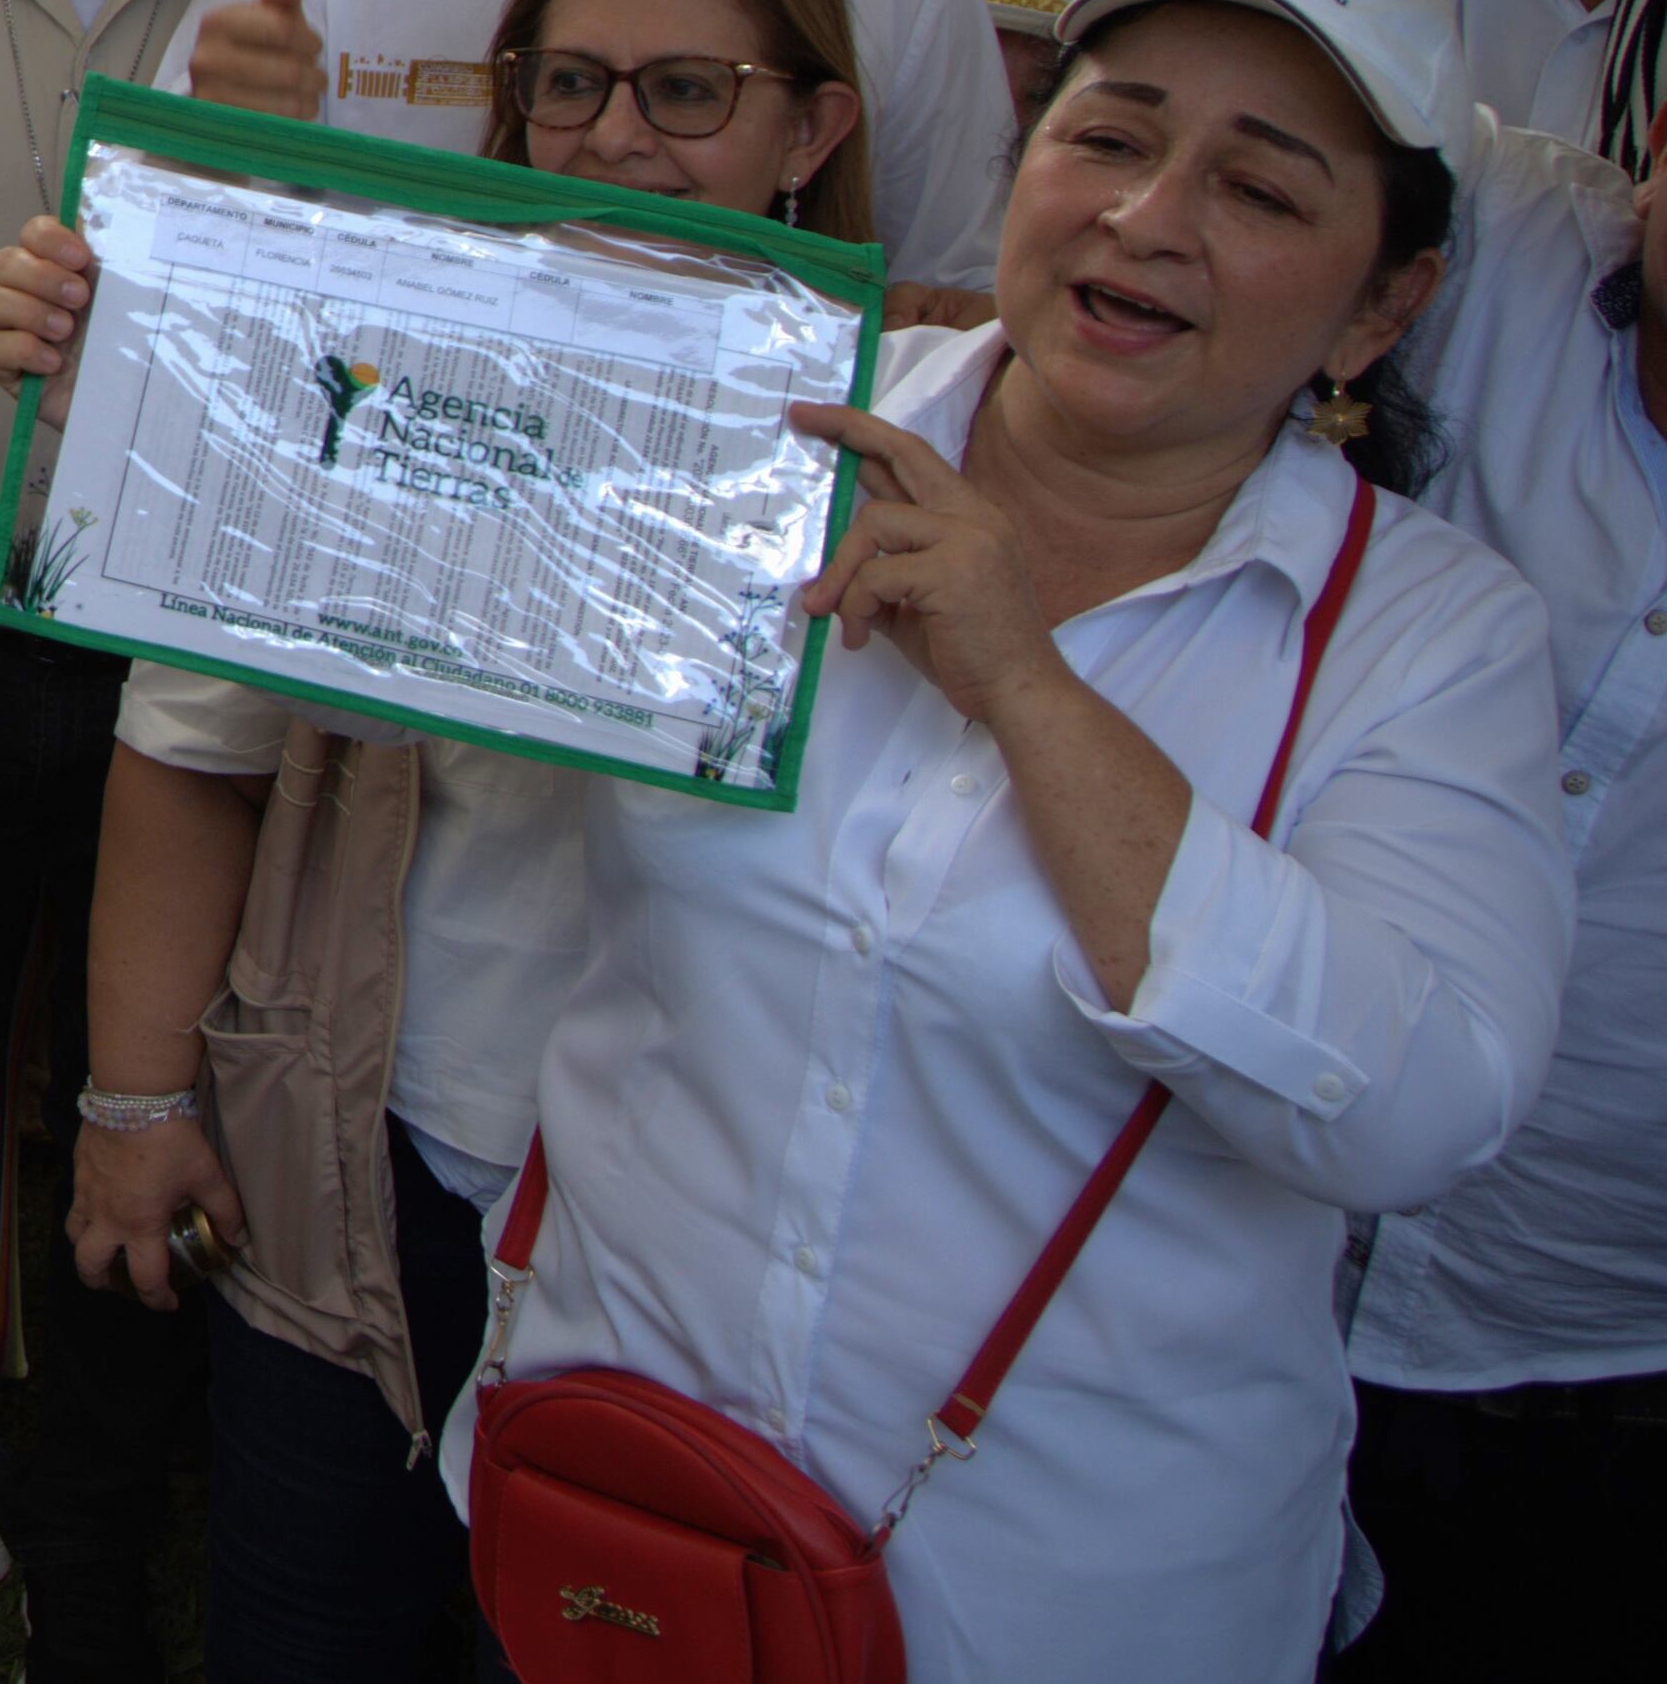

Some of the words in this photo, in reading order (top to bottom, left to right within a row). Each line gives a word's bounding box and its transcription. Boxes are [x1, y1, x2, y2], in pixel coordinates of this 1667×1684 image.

[168, 195, 248, 221] DEPARTAMENTO
[264, 217, 315, 235] MUNICIPIO
[337, 231, 378, 249] CÉDULA
[431, 251, 475, 267] NOMBRE
[529, 268, 571, 287] CÉDULA
[628, 288, 675, 308] NOMBRE
[255, 247, 312, 268] FLORENCIA
[395, 276, 435, 295] ANABEL
[436, 282, 473, 303] GÓMEZ
[473, 291, 499, 307] RUIZ
[387, 376, 546, 441] Agencia
[371, 448, 513, 512] Tierras
[378, 410, 554, 481] Nacional
[548, 464, 584, 490] de
[160, 591, 210, 622] Línea
[213, 605, 288, 641] Nacional
[290, 623, 315, 644] de
[319, 629, 398, 667] Atención
[400, 647, 419, 669] al
[420, 654, 517, 694] Ciudadano
[518, 677, 542, 700] 01
[543, 686, 589, 713] 8000
[590, 697, 657, 729] 933881
[316, 611, 464, 660] www.ant.gov.co
